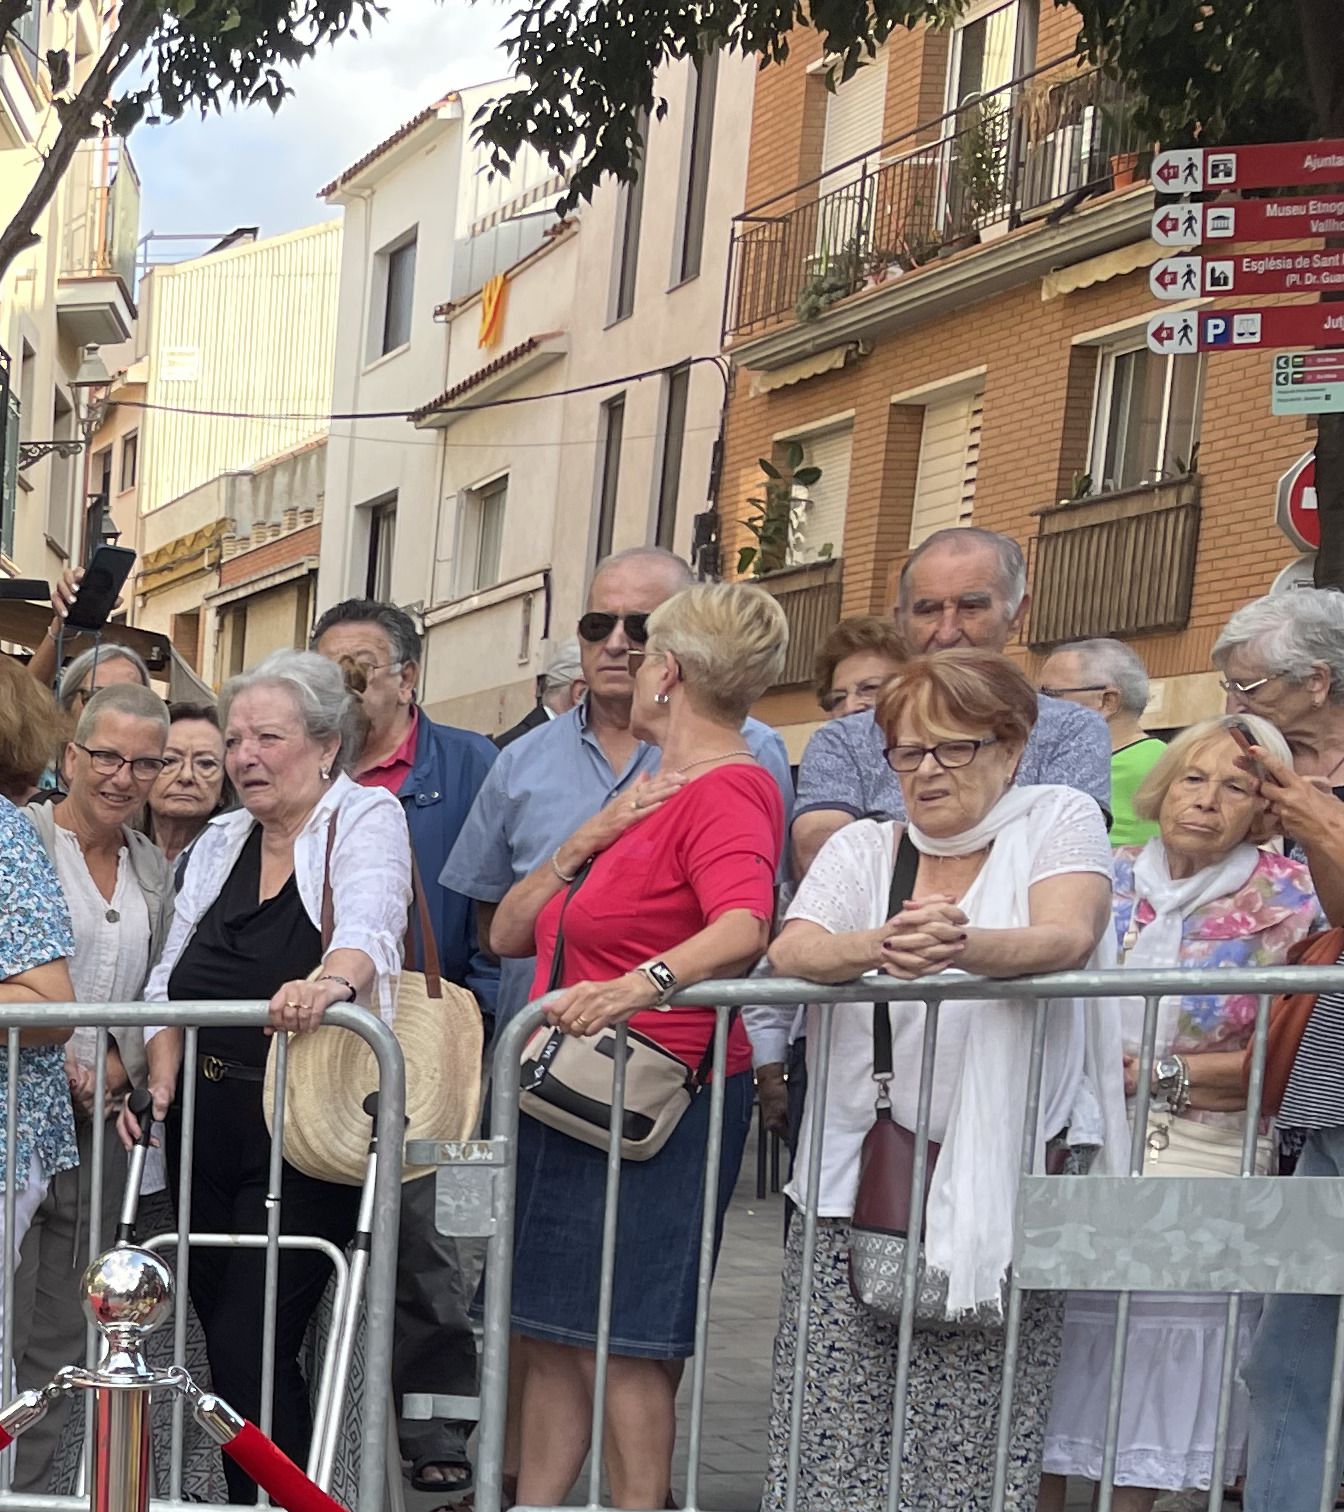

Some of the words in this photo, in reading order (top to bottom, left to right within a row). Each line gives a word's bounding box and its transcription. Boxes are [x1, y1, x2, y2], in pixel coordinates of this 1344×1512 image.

[1266, 203, 1306, 217] Museu
[1243, 256, 1292, 274] Església
[1295, 256, 1310, 269] de
[1313, 253, 1340, 267] Sant
[1305, 272, 1320, 285] Dr.
[1207, 318, 1225, 343] P
